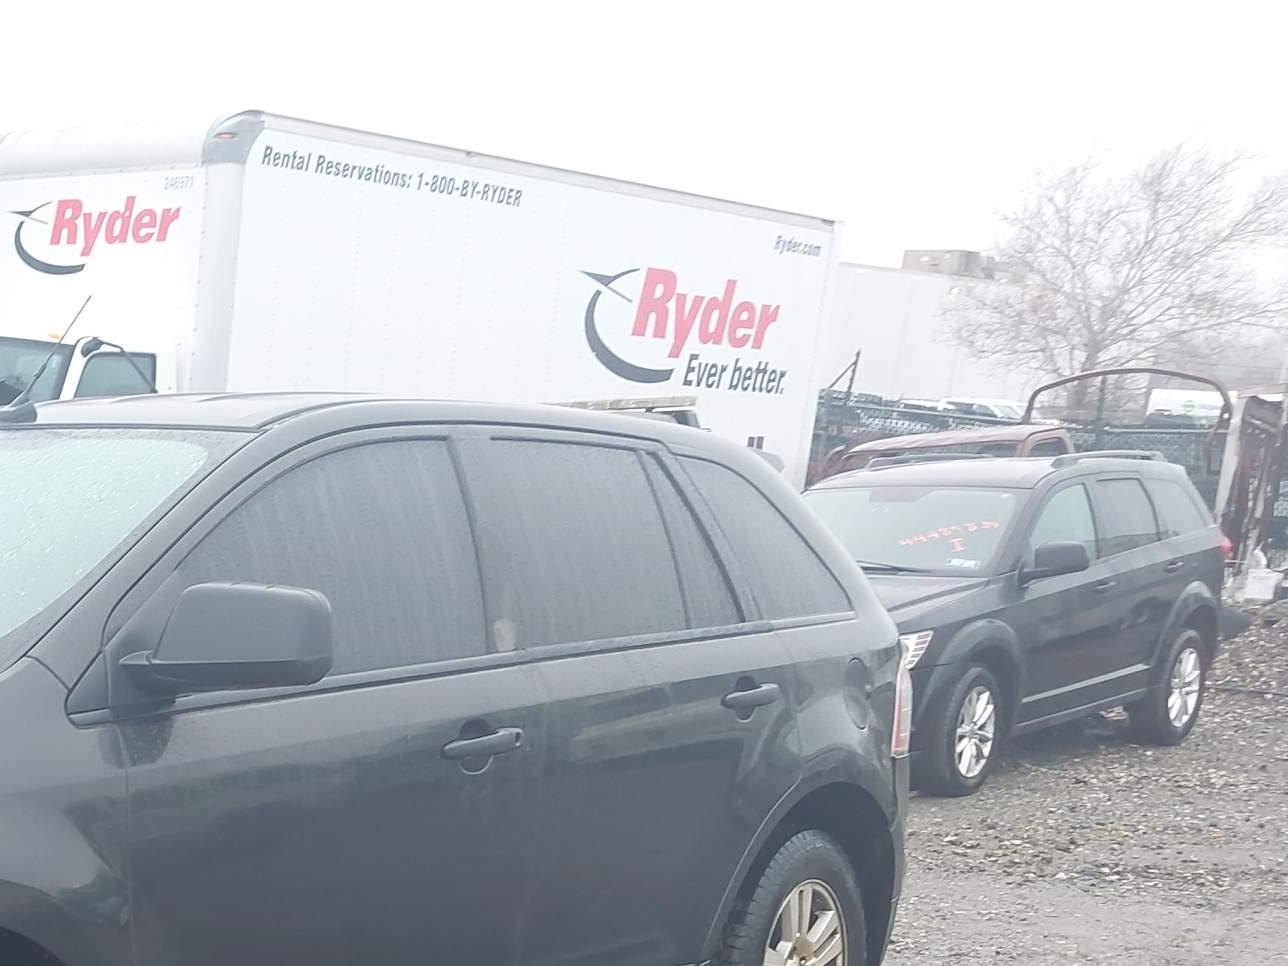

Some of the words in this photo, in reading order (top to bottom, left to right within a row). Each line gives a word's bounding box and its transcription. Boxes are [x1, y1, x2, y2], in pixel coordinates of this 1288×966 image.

[262, 145, 312, 172] Rental
[314, 154, 412, 190] Reservations:
[416, 171, 523, 207] 1-800-BY-RYDER
[49, 195, 182, 257] Ryder
[773, 234, 822, 257] Ryder.com
[631, 267, 781, 358] Ryder
[682, 353, 728, 389] Ever
[728, 358, 788, 394] better.
